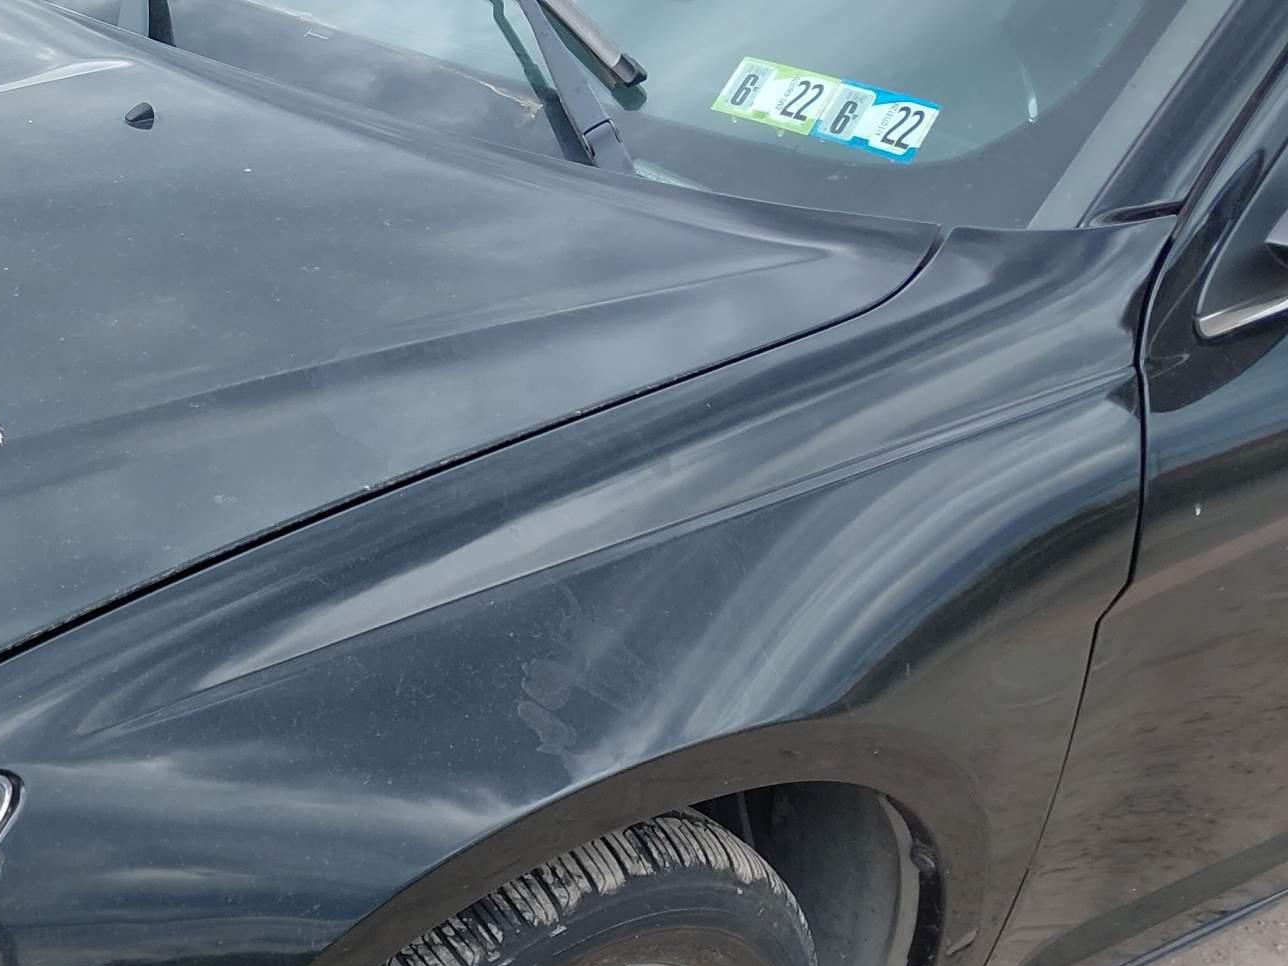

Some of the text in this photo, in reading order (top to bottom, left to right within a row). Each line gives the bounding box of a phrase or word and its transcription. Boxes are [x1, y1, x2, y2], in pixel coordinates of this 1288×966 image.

[730, 73, 759, 106] 6
[780, 80, 825, 122] 22
[830, 100, 858, 135] 6
[880, 105, 925, 150] 22
